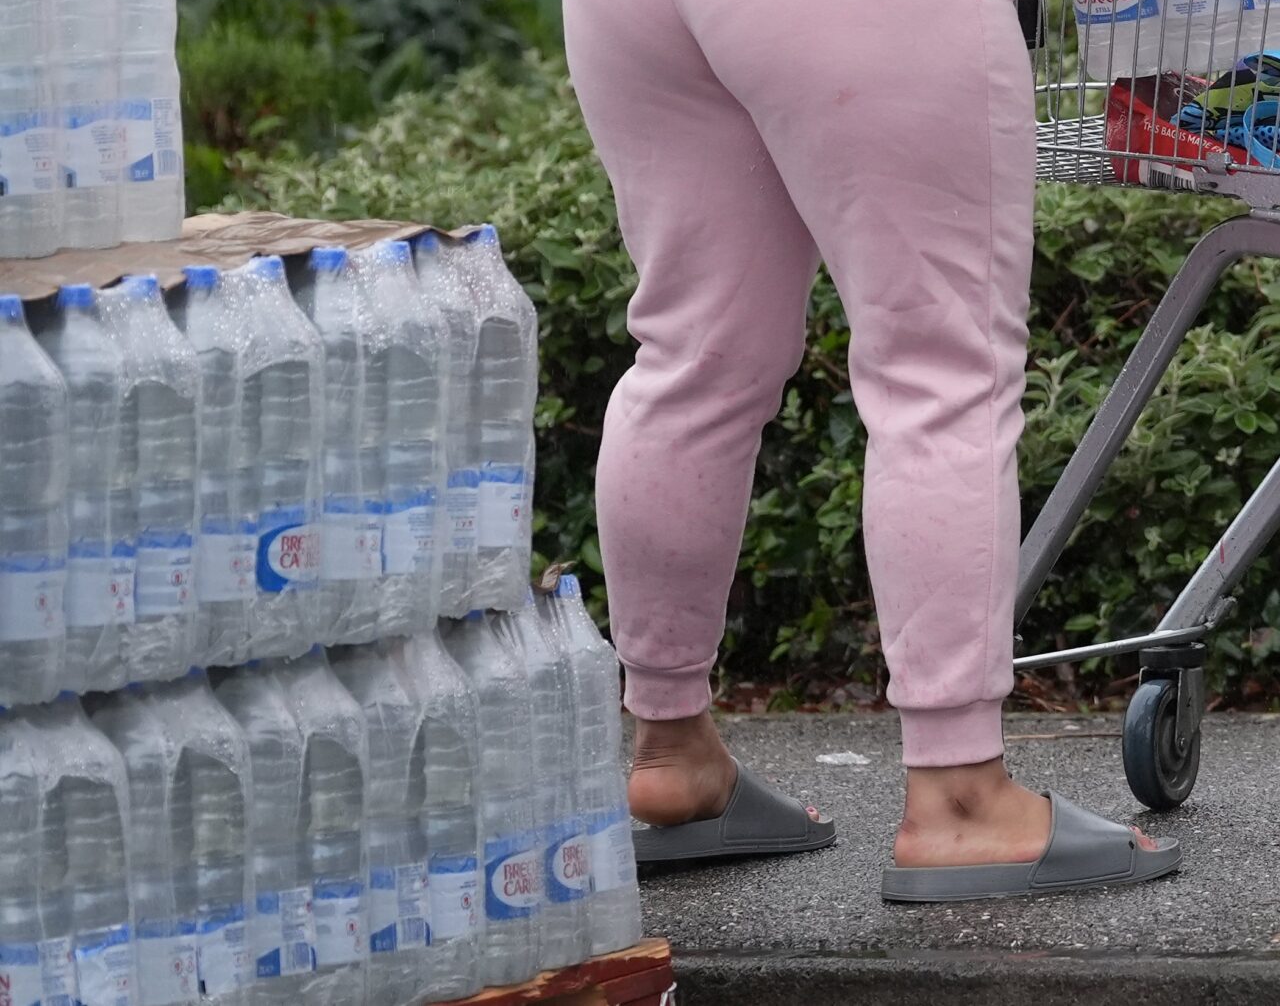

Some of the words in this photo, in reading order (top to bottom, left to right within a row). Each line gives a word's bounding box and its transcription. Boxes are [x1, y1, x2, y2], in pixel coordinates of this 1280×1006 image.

[1095, 6, 1111, 14] STILL
[1143, 121, 1160, 134] THS
[1160, 126, 1178, 139] BAG
[1179, 131, 1186, 141] IS
